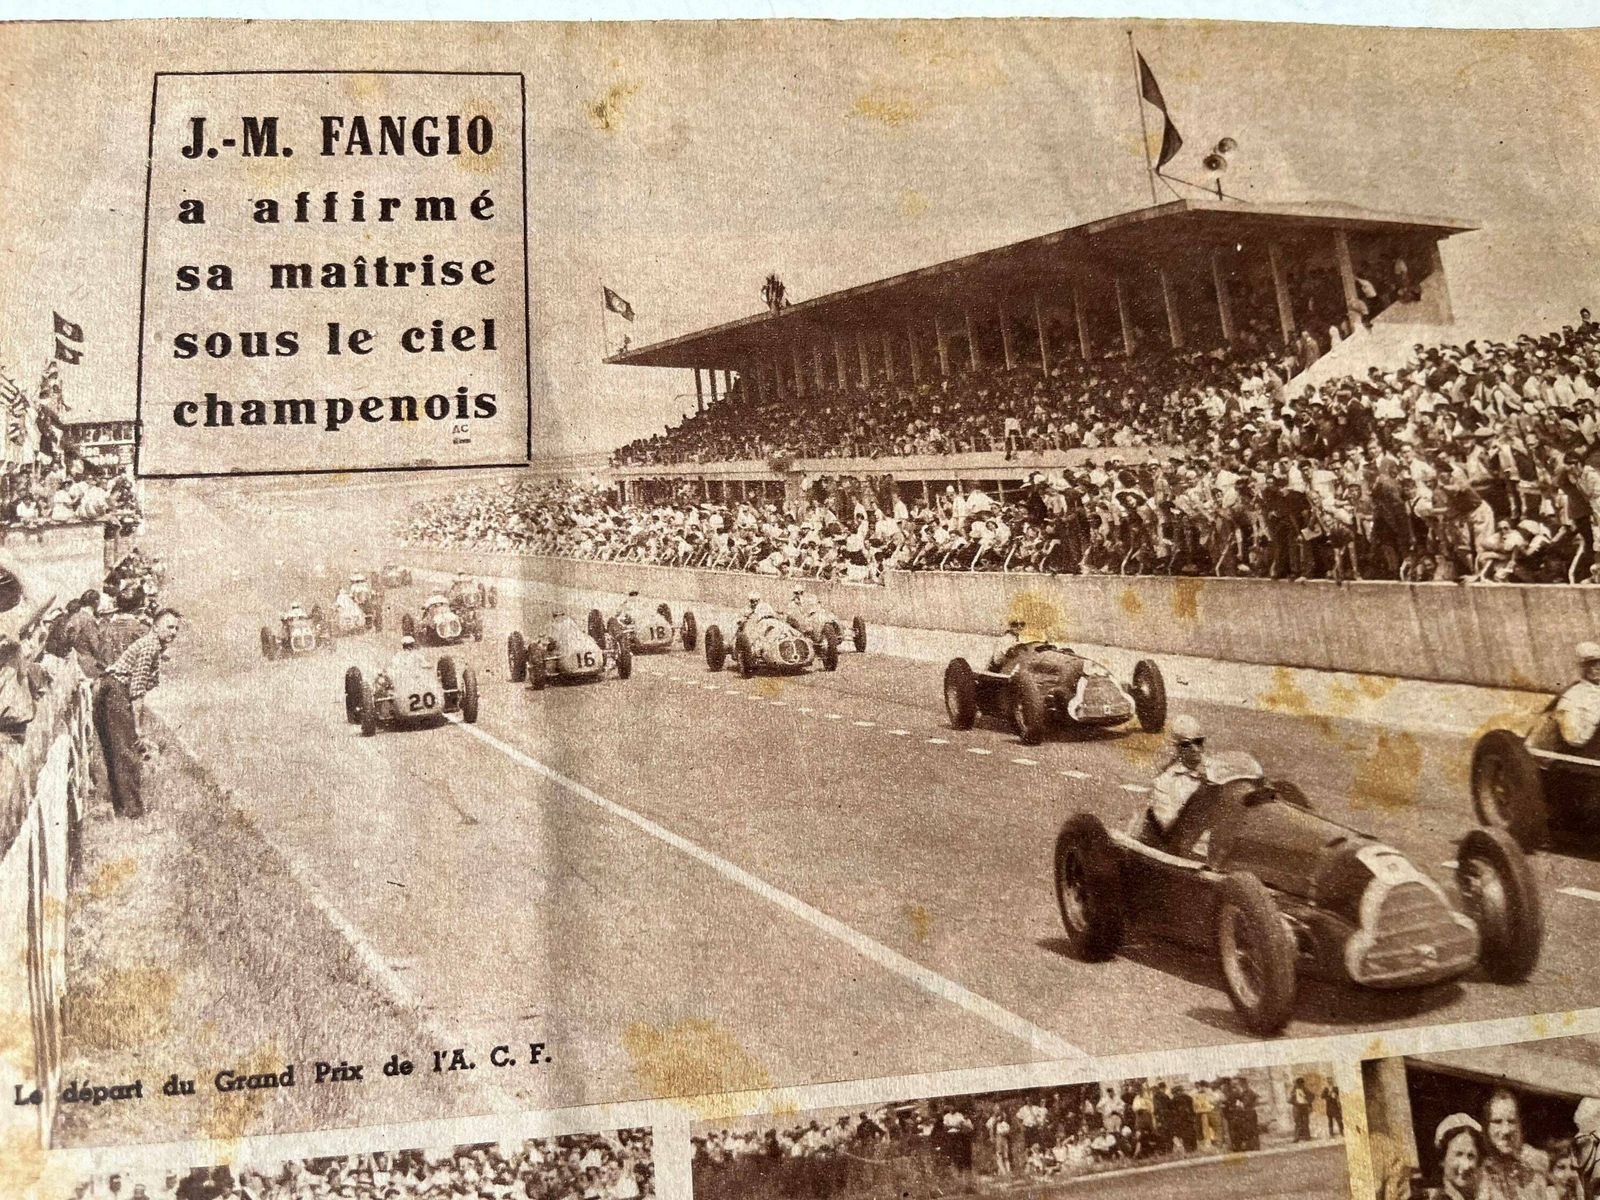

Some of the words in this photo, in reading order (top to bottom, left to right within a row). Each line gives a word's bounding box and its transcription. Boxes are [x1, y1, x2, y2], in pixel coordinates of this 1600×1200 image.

[181, 116, 294, 159] J.-M.
[320, 114, 494, 157] FANGIO
[178, 198, 205, 224] a
[252, 189, 495, 224] affirmé
[175, 262, 233, 292] sa
[269, 254, 496, 289] maîtrise
[173, 330, 300, 359] sous
[326, 322, 374, 355] le
[400, 318, 497, 354] ciel
[172, 386, 498, 432] champenois
[576, 651, 596, 669] 16
[408, 691, 436, 712] 20
[62, 1079, 144, 1106] départ
[162, 1073, 196, 1097] du
[214, 1065, 296, 1093] Grand
[314, 1060, 364, 1083] Prix
[382, 1054, 414, 1076] de
[490, 1045, 516, 1067] C.
[529, 1042, 552, 1064] F.
